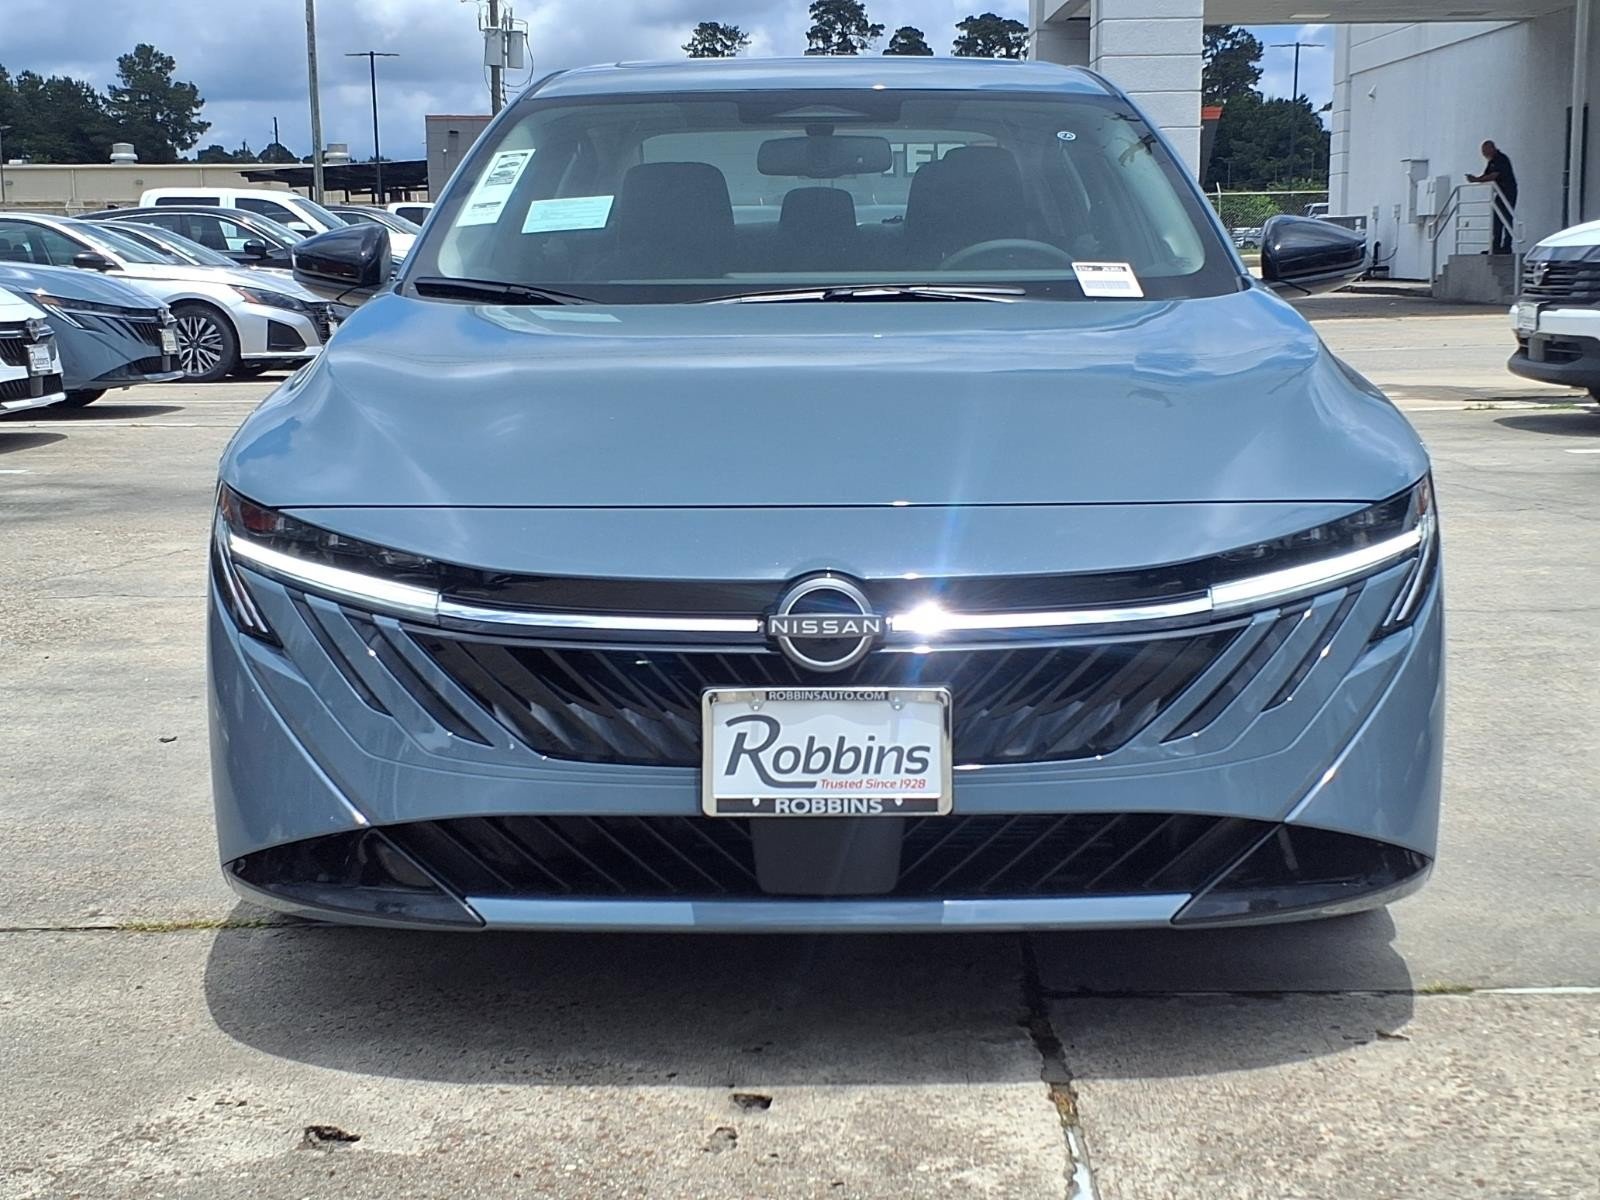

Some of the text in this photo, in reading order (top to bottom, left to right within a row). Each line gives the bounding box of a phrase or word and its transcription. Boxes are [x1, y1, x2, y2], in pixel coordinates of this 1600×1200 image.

[771, 619, 880, 634] NISSAN
[768, 690, 885, 701] ROBBINSAUTO.COM
[724, 714, 931, 788] Robbins
[820, 779, 926, 789] Trusted Since 1928
[774, 798, 883, 814] ROBBINS
